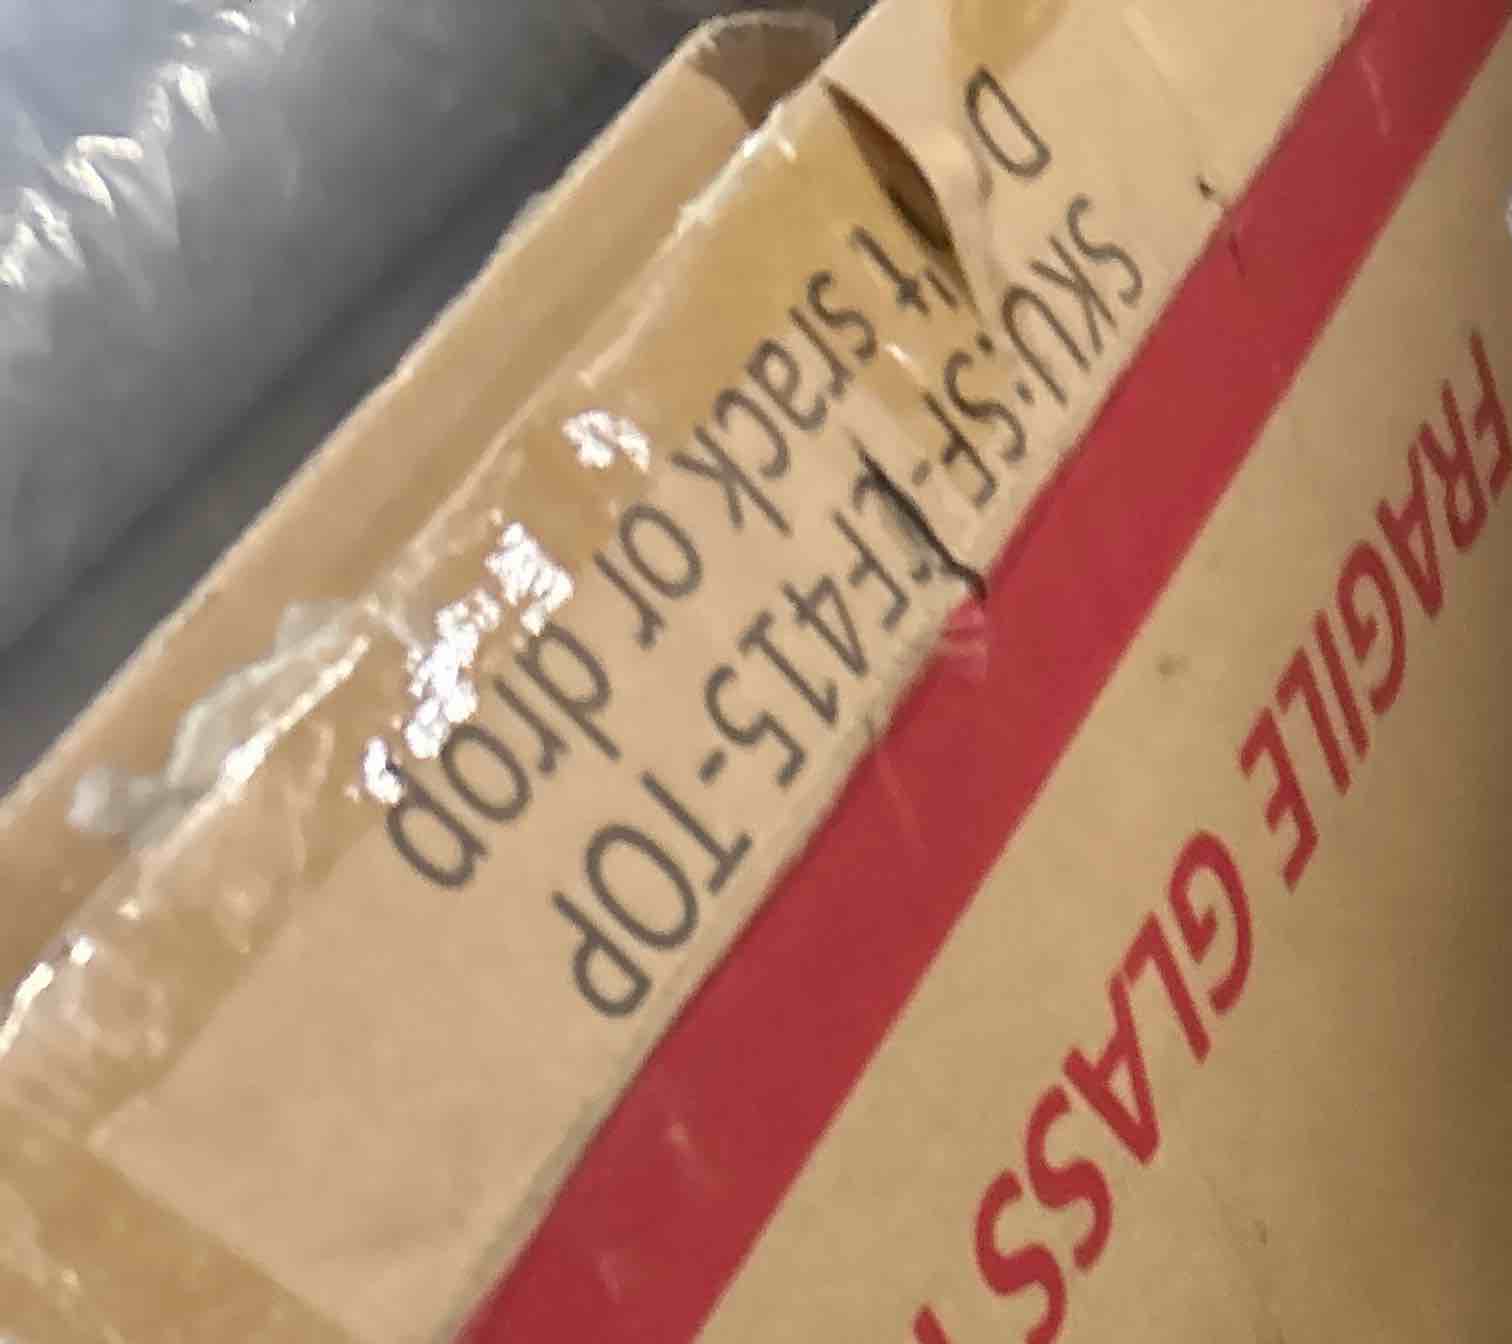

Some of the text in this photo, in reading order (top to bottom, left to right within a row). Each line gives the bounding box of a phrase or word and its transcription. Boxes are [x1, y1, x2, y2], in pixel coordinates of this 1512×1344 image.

[671, 269, 877, 535] srack
[593, 504, 704, 650] or
[383, 624, 621, 891] drop
